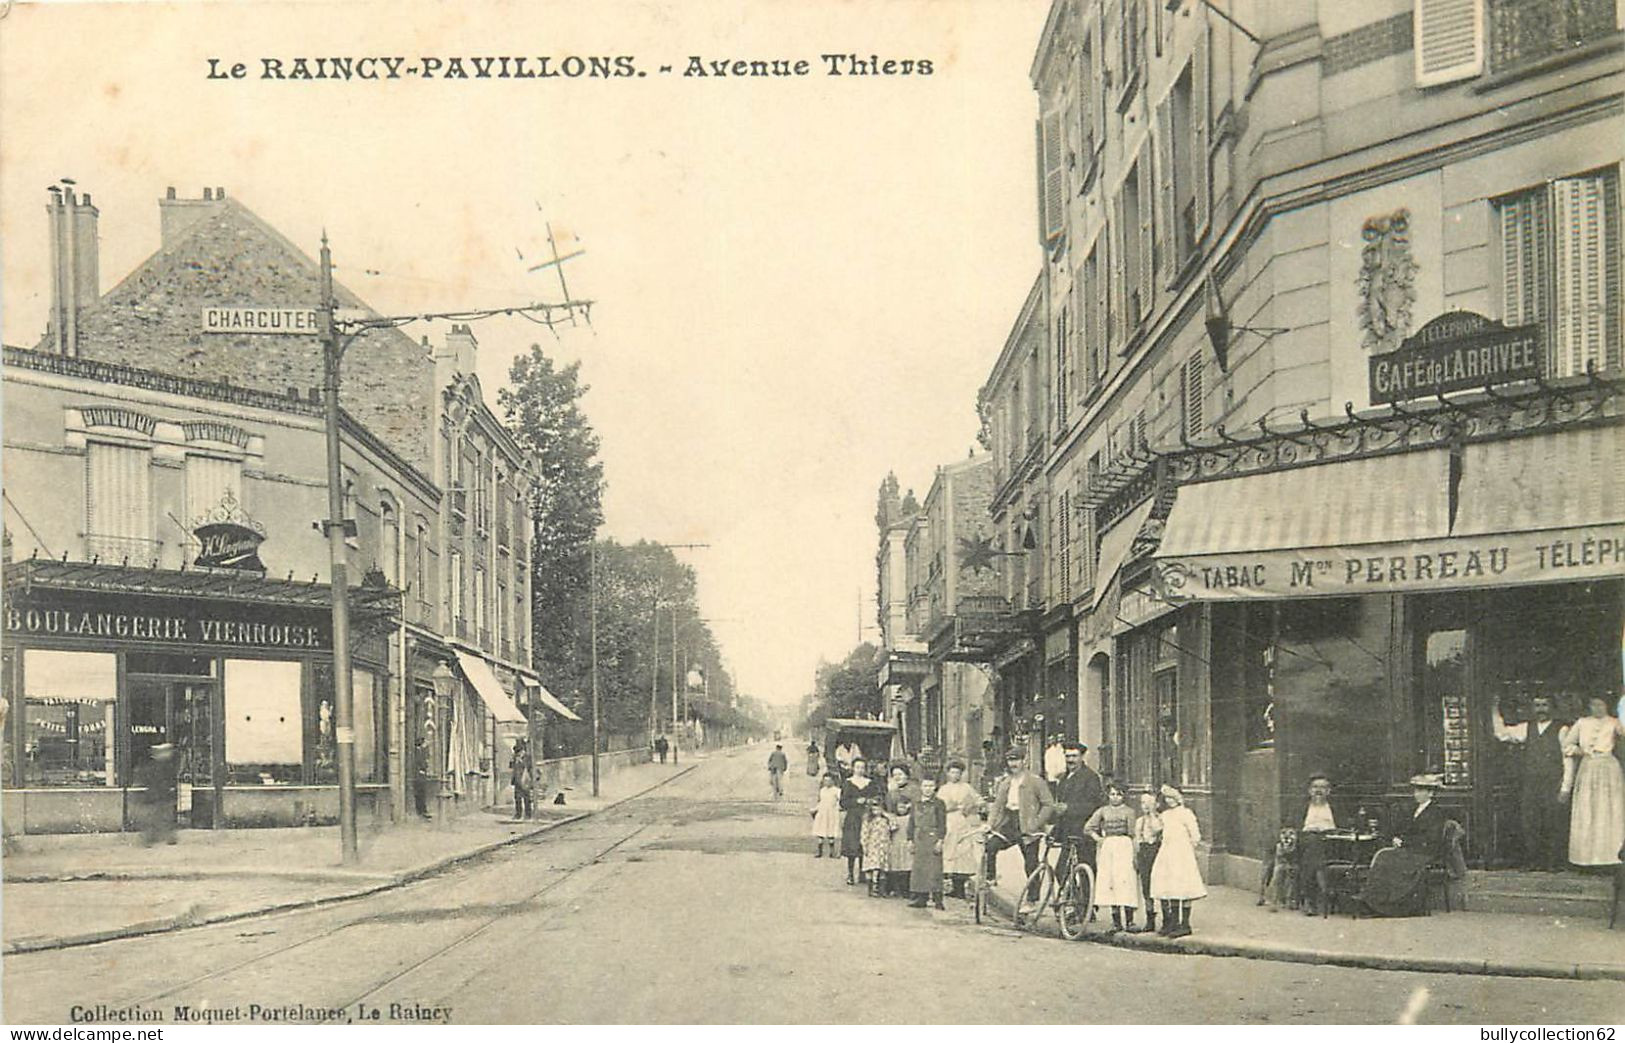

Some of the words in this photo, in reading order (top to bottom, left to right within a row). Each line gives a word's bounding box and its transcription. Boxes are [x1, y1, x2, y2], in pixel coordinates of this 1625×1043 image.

[1375, 355, 1426, 393] CAFÉ
[1201, 564, 1266, 589] TABAC
[1344, 547, 1510, 584] PERREAU
[6, 607, 188, 641] BOULANGERIE
[199, 619, 320, 647] VIENNOISE
